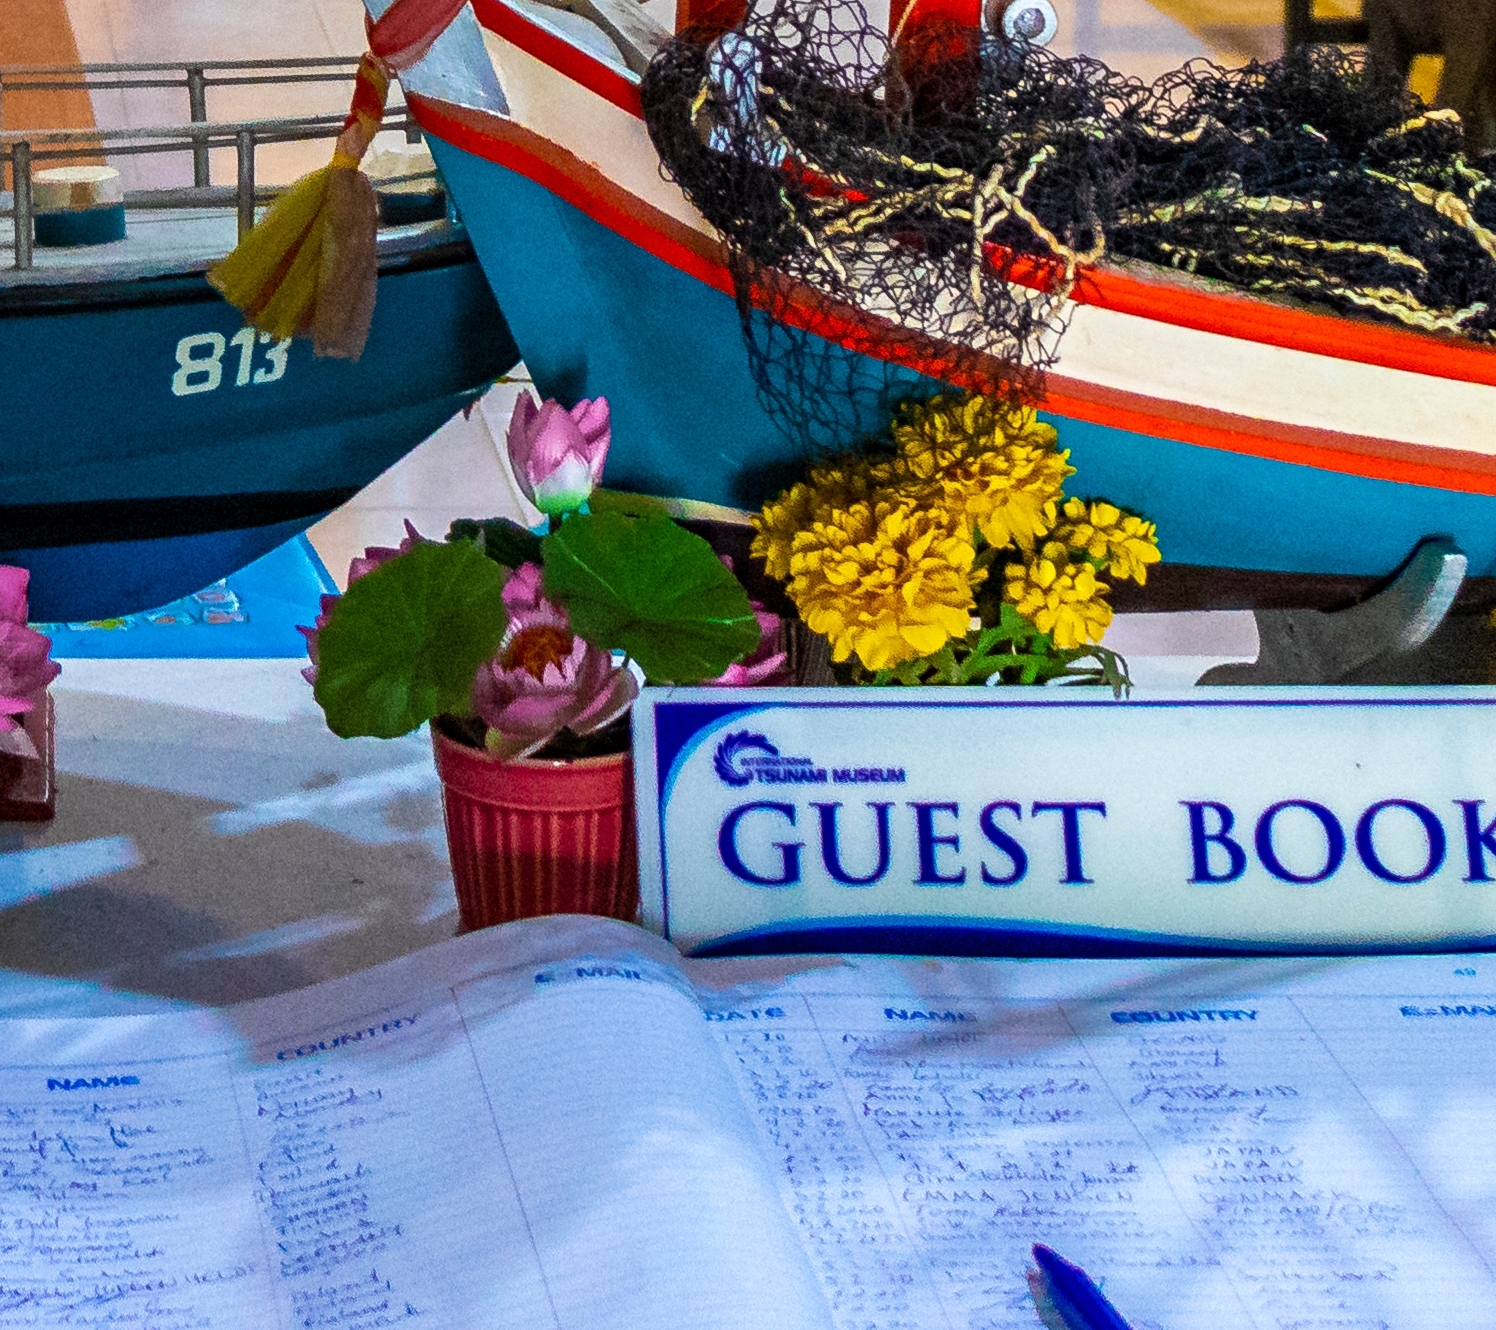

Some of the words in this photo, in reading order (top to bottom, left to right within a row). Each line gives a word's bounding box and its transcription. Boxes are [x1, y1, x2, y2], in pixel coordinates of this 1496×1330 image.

[170, 324, 295, 398] 813
[754, 767, 828, 783] TSUNAMI
[831, 767, 906, 783] MUSEUM
[714, 796, 1110, 888] GUEST
[1109, 1008, 1259, 1027] COUNTRY
[45, 1073, 142, 1093] NAME
